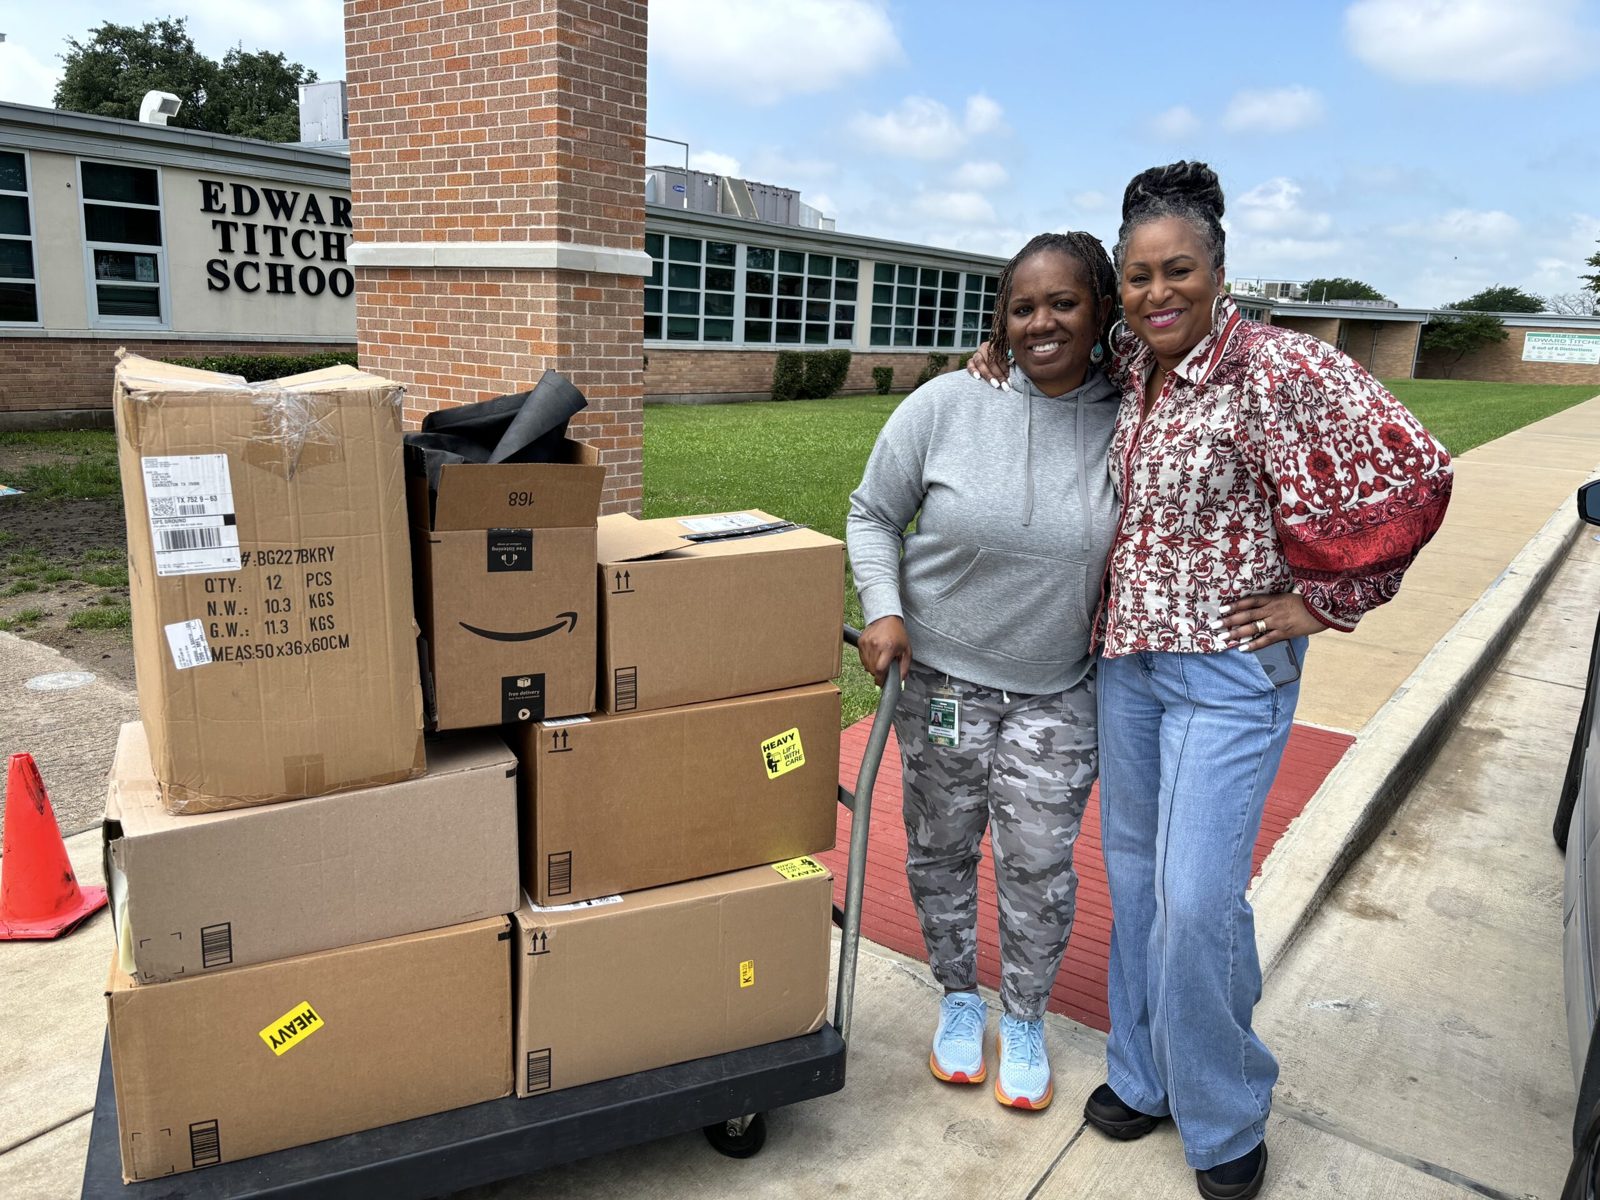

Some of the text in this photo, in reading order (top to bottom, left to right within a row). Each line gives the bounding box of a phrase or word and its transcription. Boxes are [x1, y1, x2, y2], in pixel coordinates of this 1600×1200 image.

[198, 179, 353, 228] EDWAR
[212, 219, 353, 263] TITCH
[206, 258, 355, 297] SCHOO
[508, 491, 535, 506] 168
[266, 574, 282, 591] 12
[306, 571, 333, 588] PCS
[264, 597, 291, 614] 10.3
[309, 592, 334, 609] KGS
[264, 619, 289, 635] 11.3
[310, 614, 335, 632] KGS
[763, 732, 795, 752] HEAVY
[782, 744, 796, 754] LIFT
[784, 749, 800, 760] WITH
[785, 754, 803, 766] CARE
[791, 868, 824, 878] HEAVY
[269, 1009, 318, 1050] HEAVY
